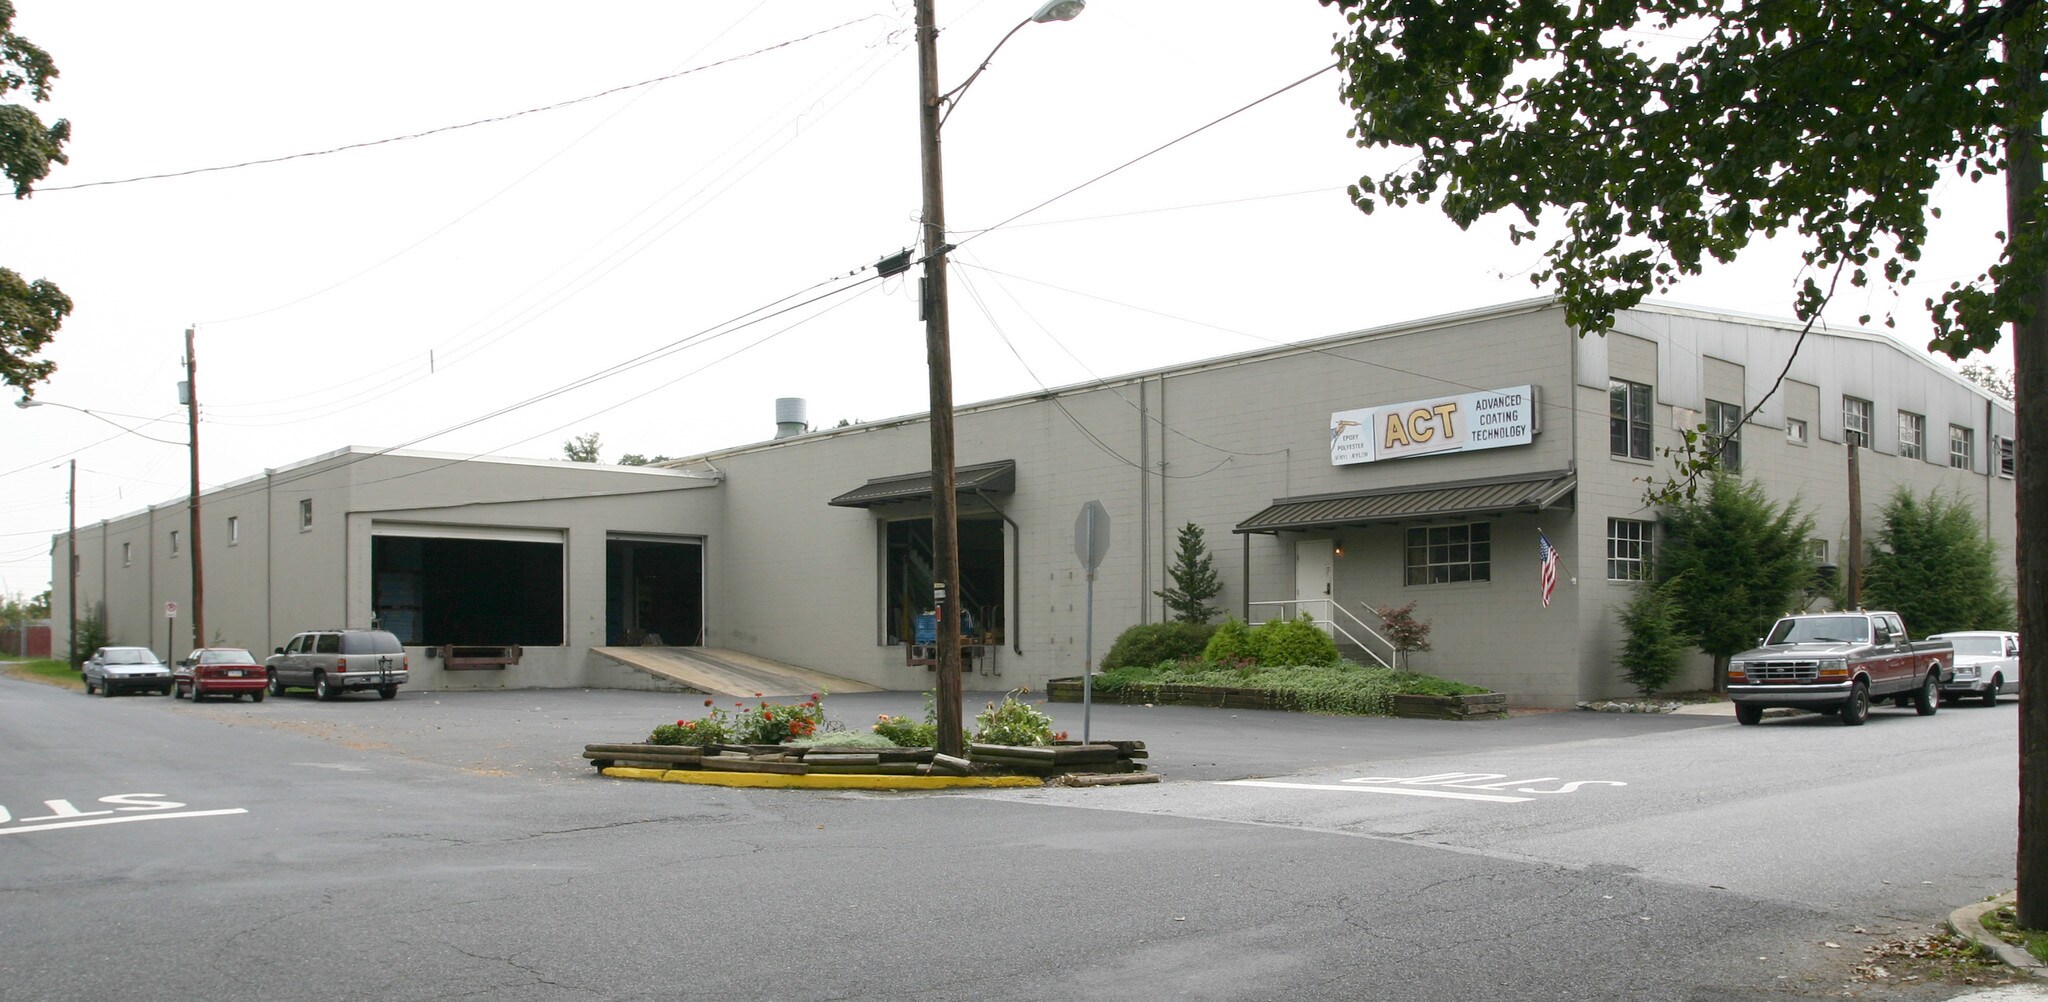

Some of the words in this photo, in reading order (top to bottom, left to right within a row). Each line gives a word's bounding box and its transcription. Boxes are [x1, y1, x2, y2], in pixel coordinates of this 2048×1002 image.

[1476, 395, 1521, 411] ADVANCED
[1385, 403, 1456, 448] ACT
[1480, 410, 1518, 425] COATING
[1472, 425, 1526, 441] TECHNOLOGY
[1337, 443, 1364, 451] POLYESTER
[1341, 772, 1628, 793] STOP
